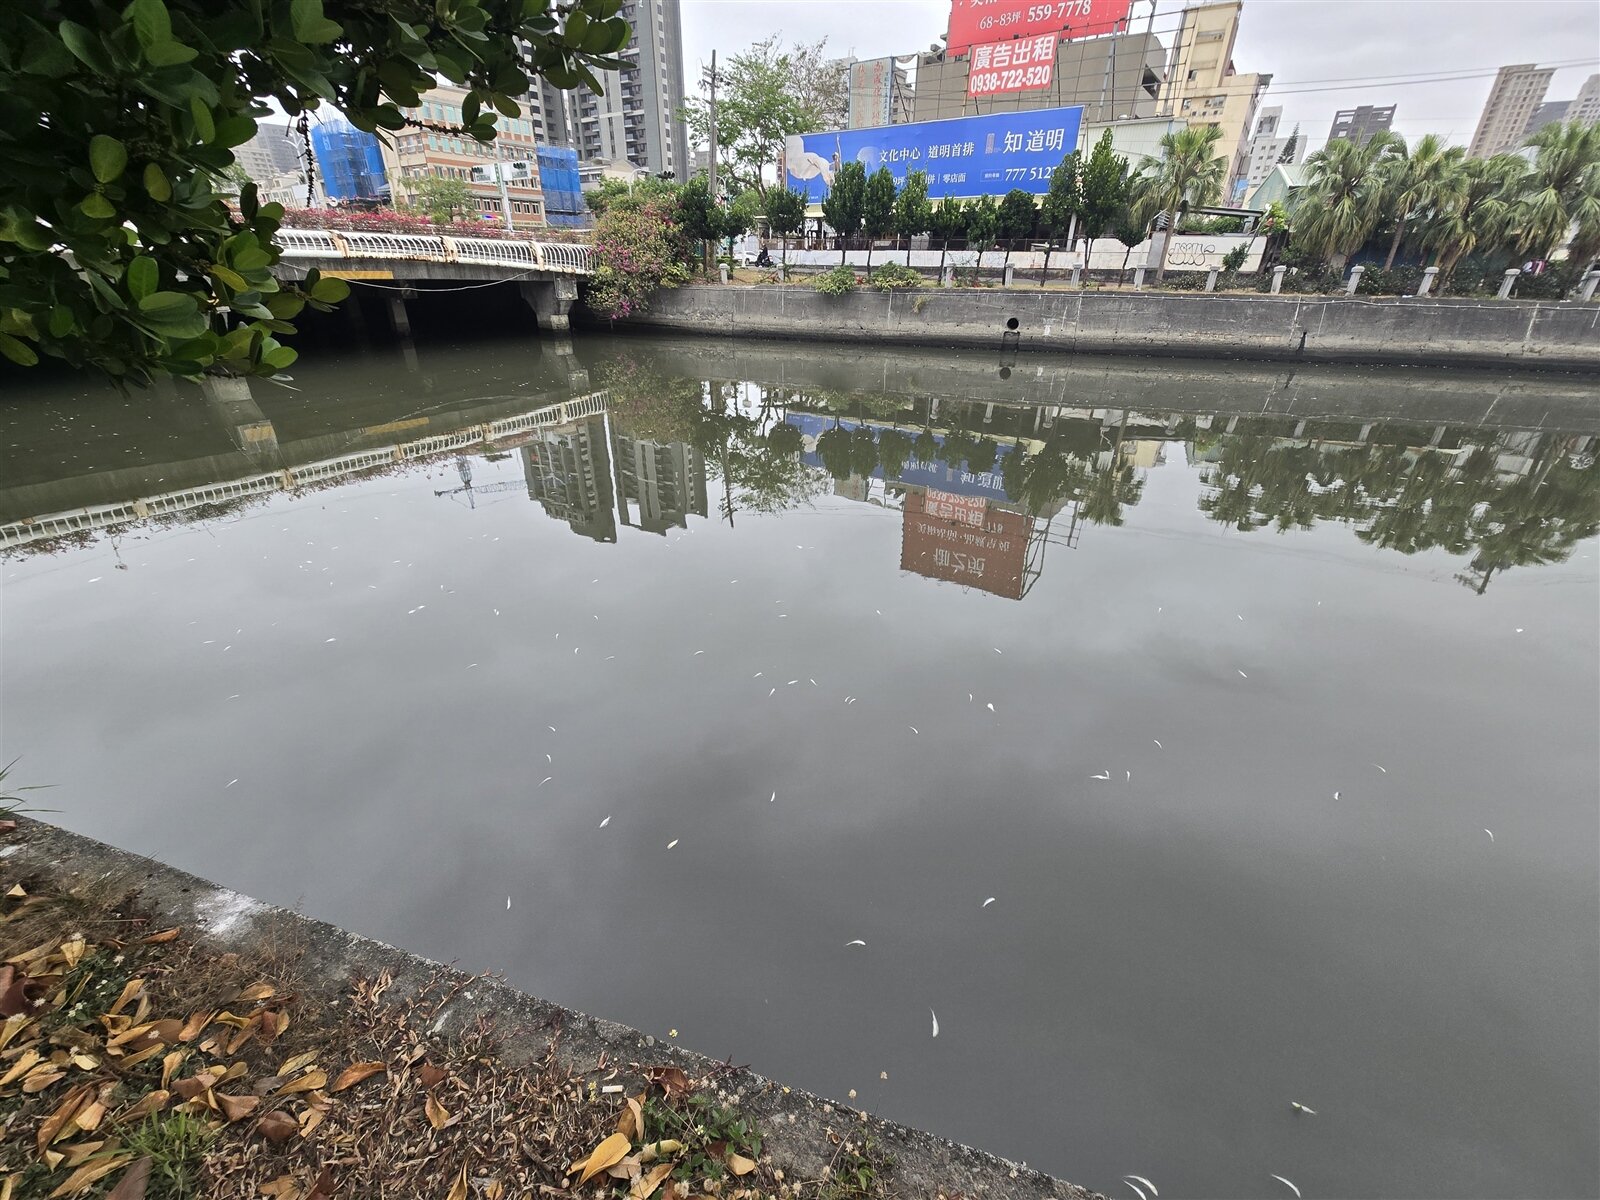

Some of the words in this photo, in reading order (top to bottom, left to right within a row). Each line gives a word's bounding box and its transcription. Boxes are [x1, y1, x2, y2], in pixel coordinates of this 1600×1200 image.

[980, 10, 1021, 30] 68~83坪
[1027, 0, 1092, 22] 559-7778
[972, 35, 1055, 71] 廣告出租
[970, 64, 1051, 94] 0938-722-520
[879, 147, 921, 163] 文化中心
[928, 142, 975, 159] 道明首排
[1003, 128, 1065, 154] 知道明
[942, 172, 967, 183] 零店面
[1005, 168, 1028, 181] 777
